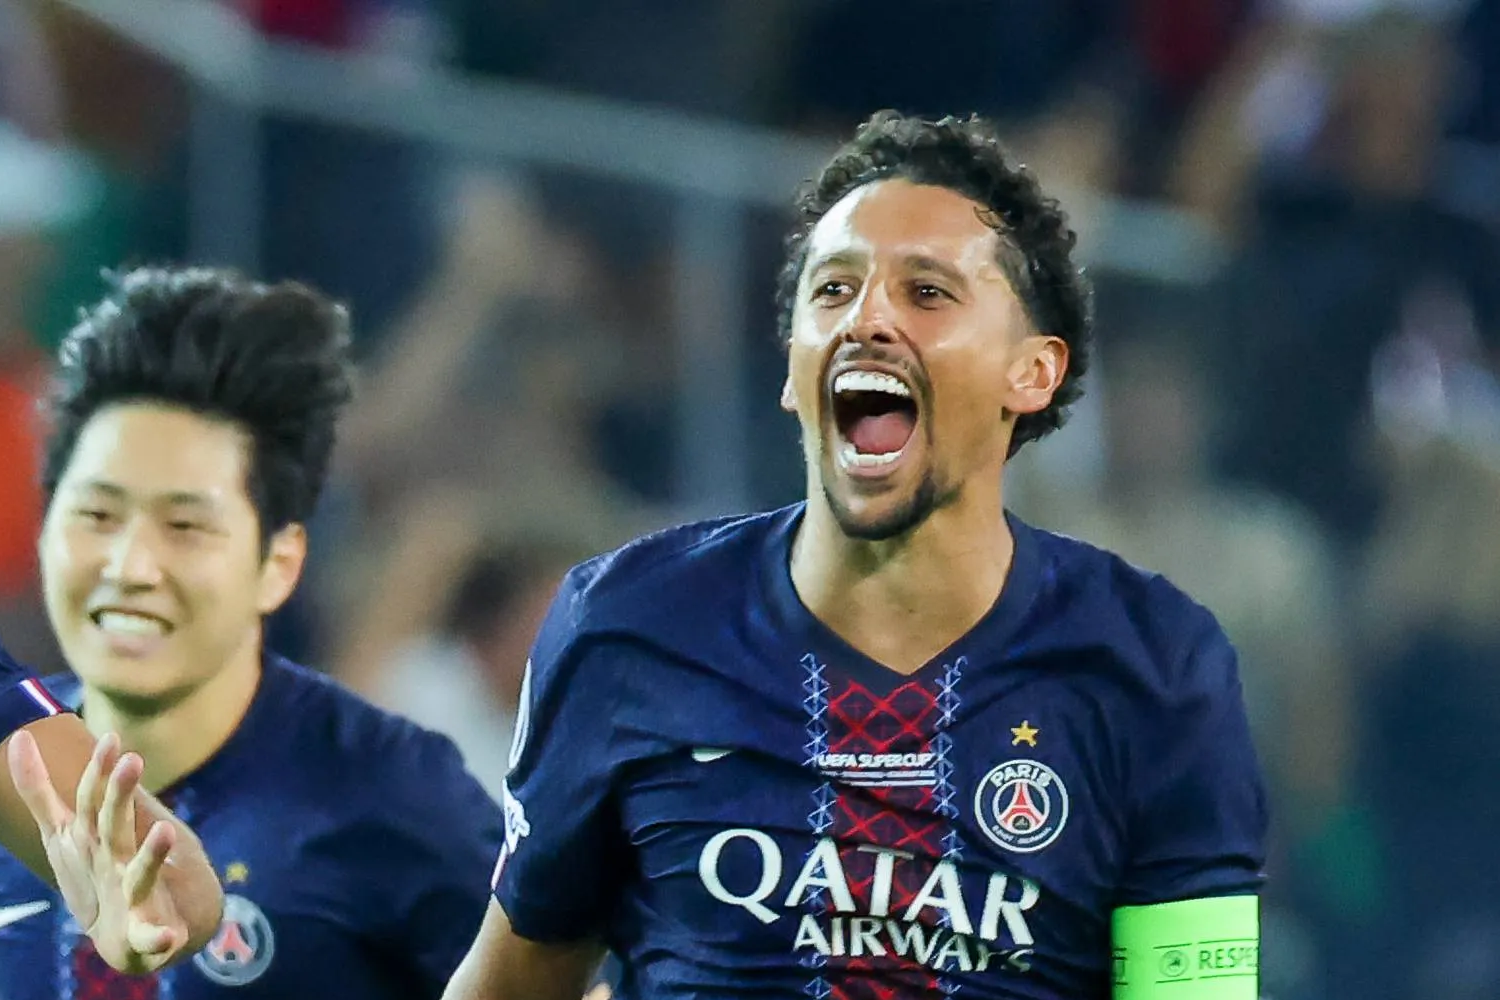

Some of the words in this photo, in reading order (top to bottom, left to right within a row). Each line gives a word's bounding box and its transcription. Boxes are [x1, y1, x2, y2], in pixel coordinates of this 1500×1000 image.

[819, 753, 857, 768] UEFA
[990, 764, 1052, 788] PARIS
[699, 828, 1040, 945] QATAR
[1199, 947, 1258, 970] RESPE
